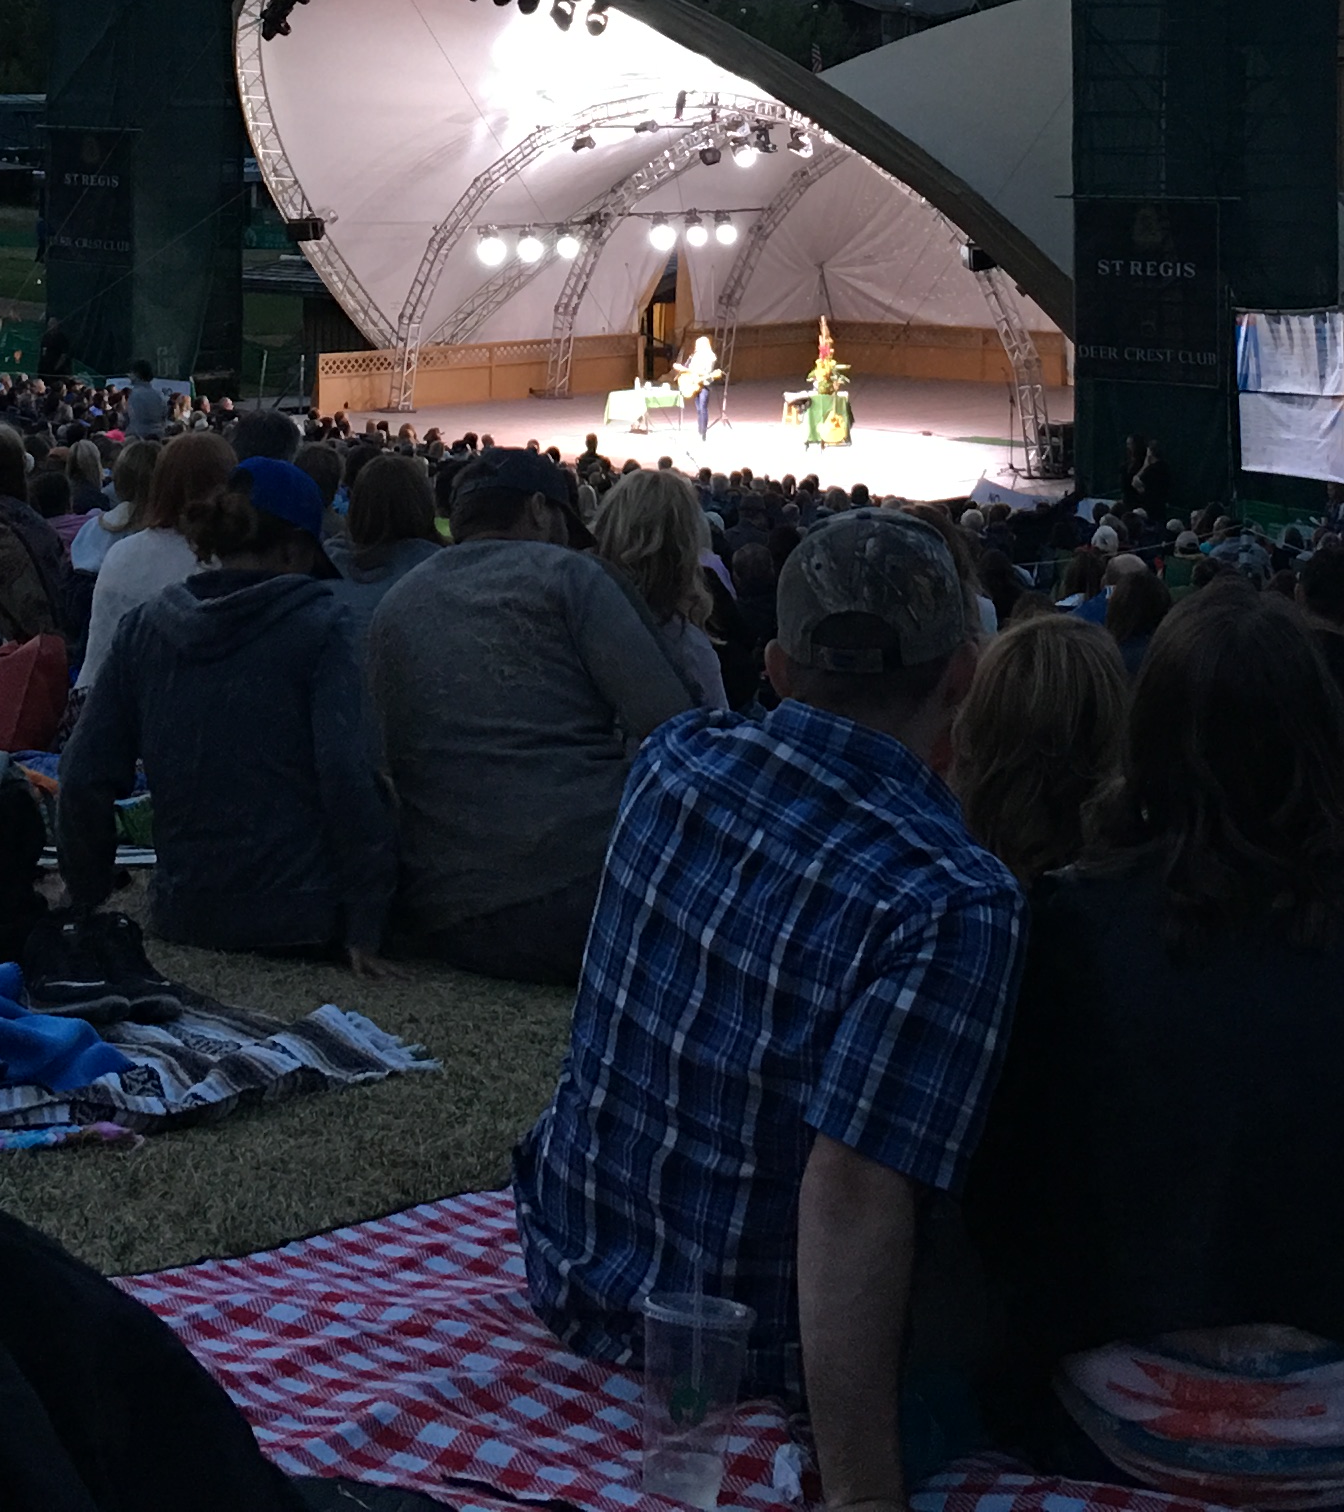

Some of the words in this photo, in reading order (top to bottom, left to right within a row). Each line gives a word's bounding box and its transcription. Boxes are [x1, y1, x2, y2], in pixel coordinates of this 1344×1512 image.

[81, 174, 120, 188] REGIS
[1129, 260, 1197, 279] REGIS
[1078, 344, 1119, 361] DEER
[1123, 346, 1174, 364] CREST
[1177, 349, 1217, 366] CLUB
